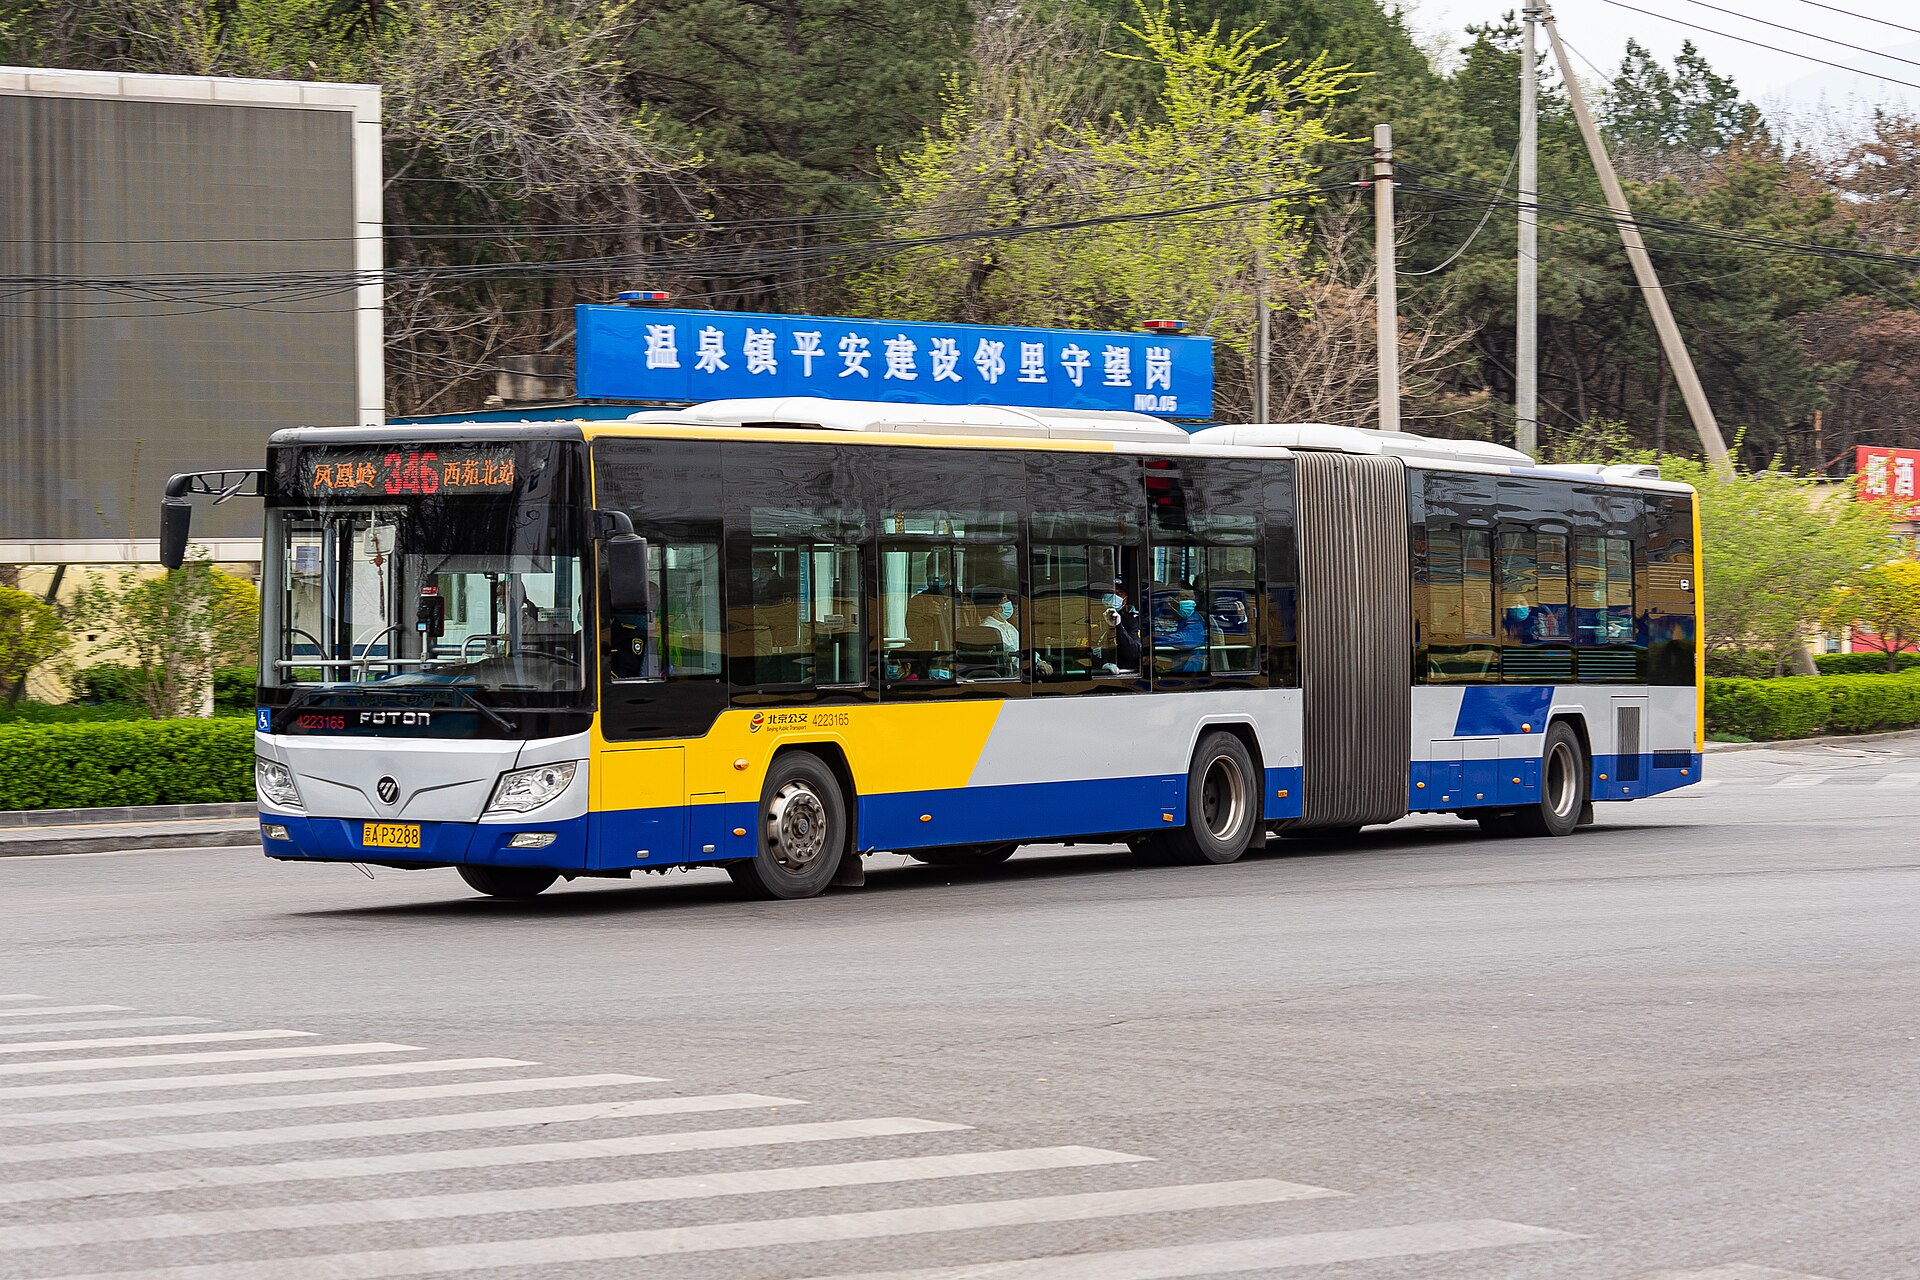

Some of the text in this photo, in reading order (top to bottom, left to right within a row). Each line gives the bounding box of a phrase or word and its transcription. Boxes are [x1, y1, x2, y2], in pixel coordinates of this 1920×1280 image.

[644, 324, 1172, 390] 温泉镇平安建设邻里守望岗
[313, 452, 515, 494] 凤凰岭 346 西苑北站
[296, 715, 345, 729] 4223165
[360, 711, 431, 725] FOTON
[767, 713, 808, 725] 北京公交
[812, 713, 849, 727] 4223165
